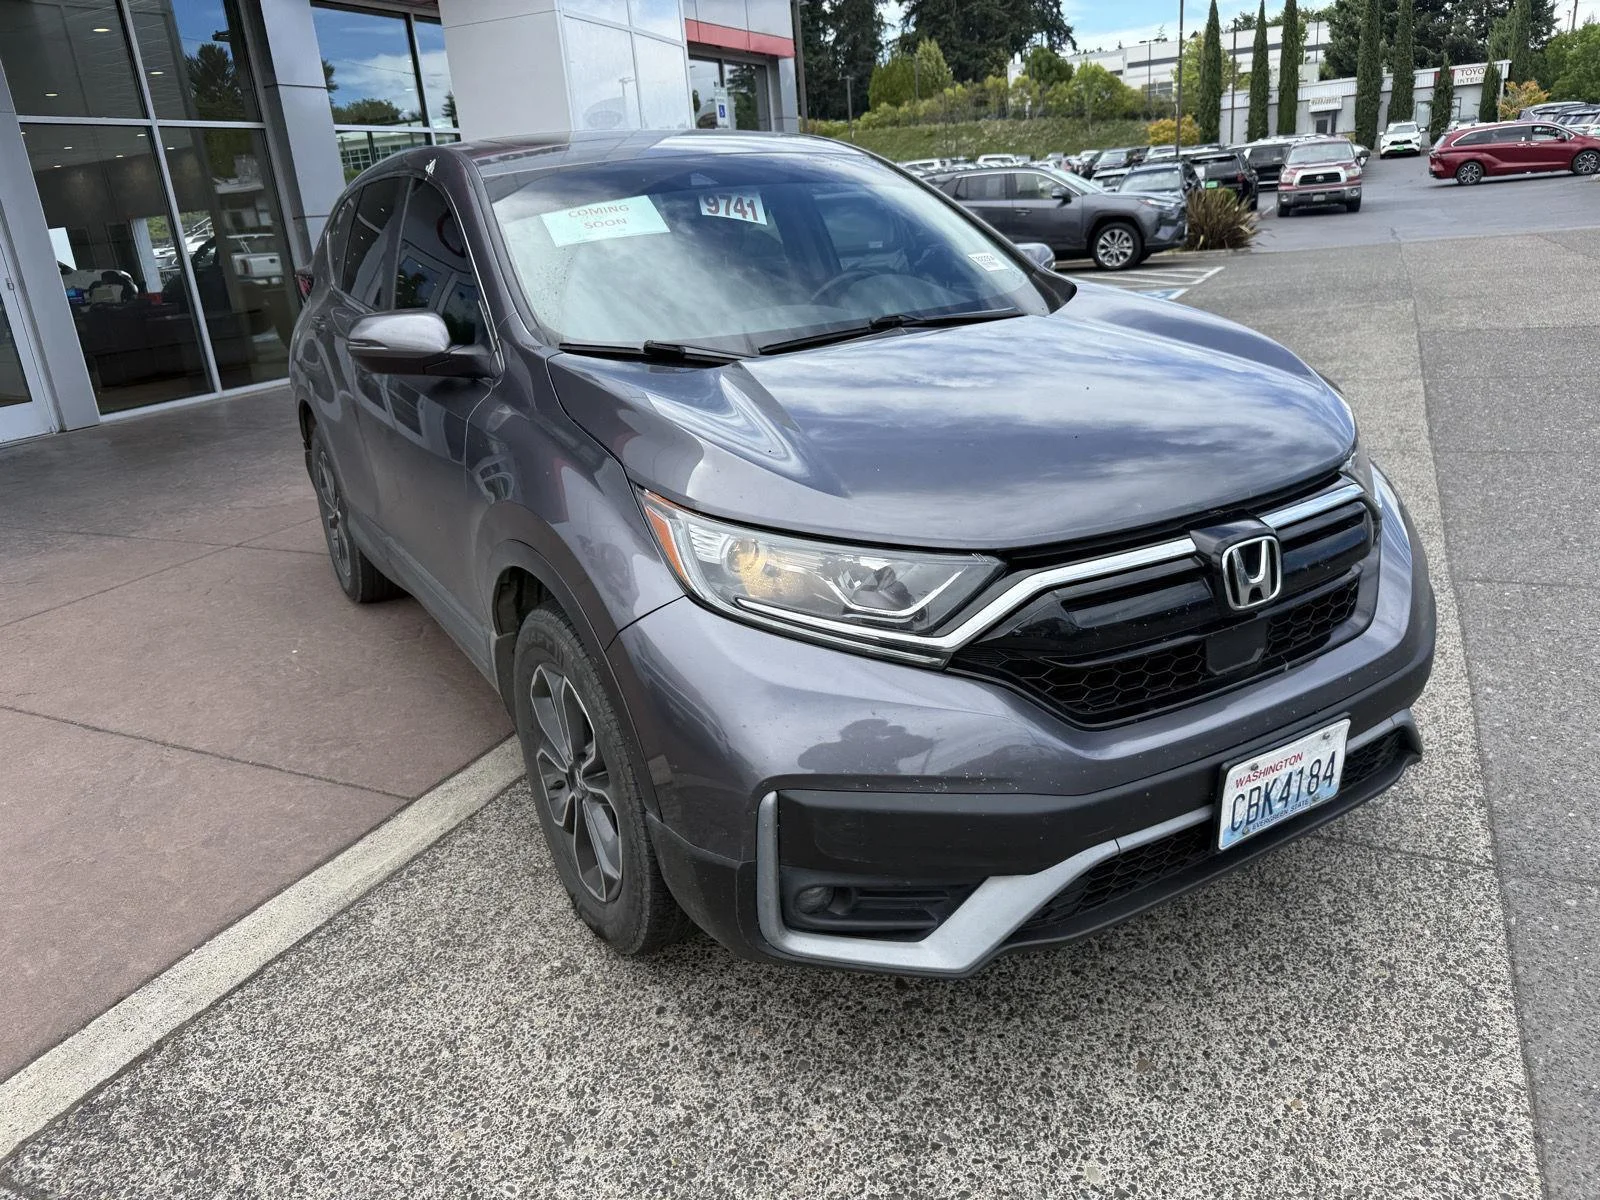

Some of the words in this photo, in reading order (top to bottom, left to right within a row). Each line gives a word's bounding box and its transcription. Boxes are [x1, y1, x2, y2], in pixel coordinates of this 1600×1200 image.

[1461, 67, 1485, 77] TOYO
[568, 204, 630, 218] COMING
[703, 195, 758, 221] 9741
[584, 218, 627, 229] SOON
[1235, 752, 1303, 788] WASHINGTON
[1231, 751, 1336, 832] CBK4184
[1252, 810, 1289, 830] EVERGREEN
[1290, 799, 1309, 812] STATE
